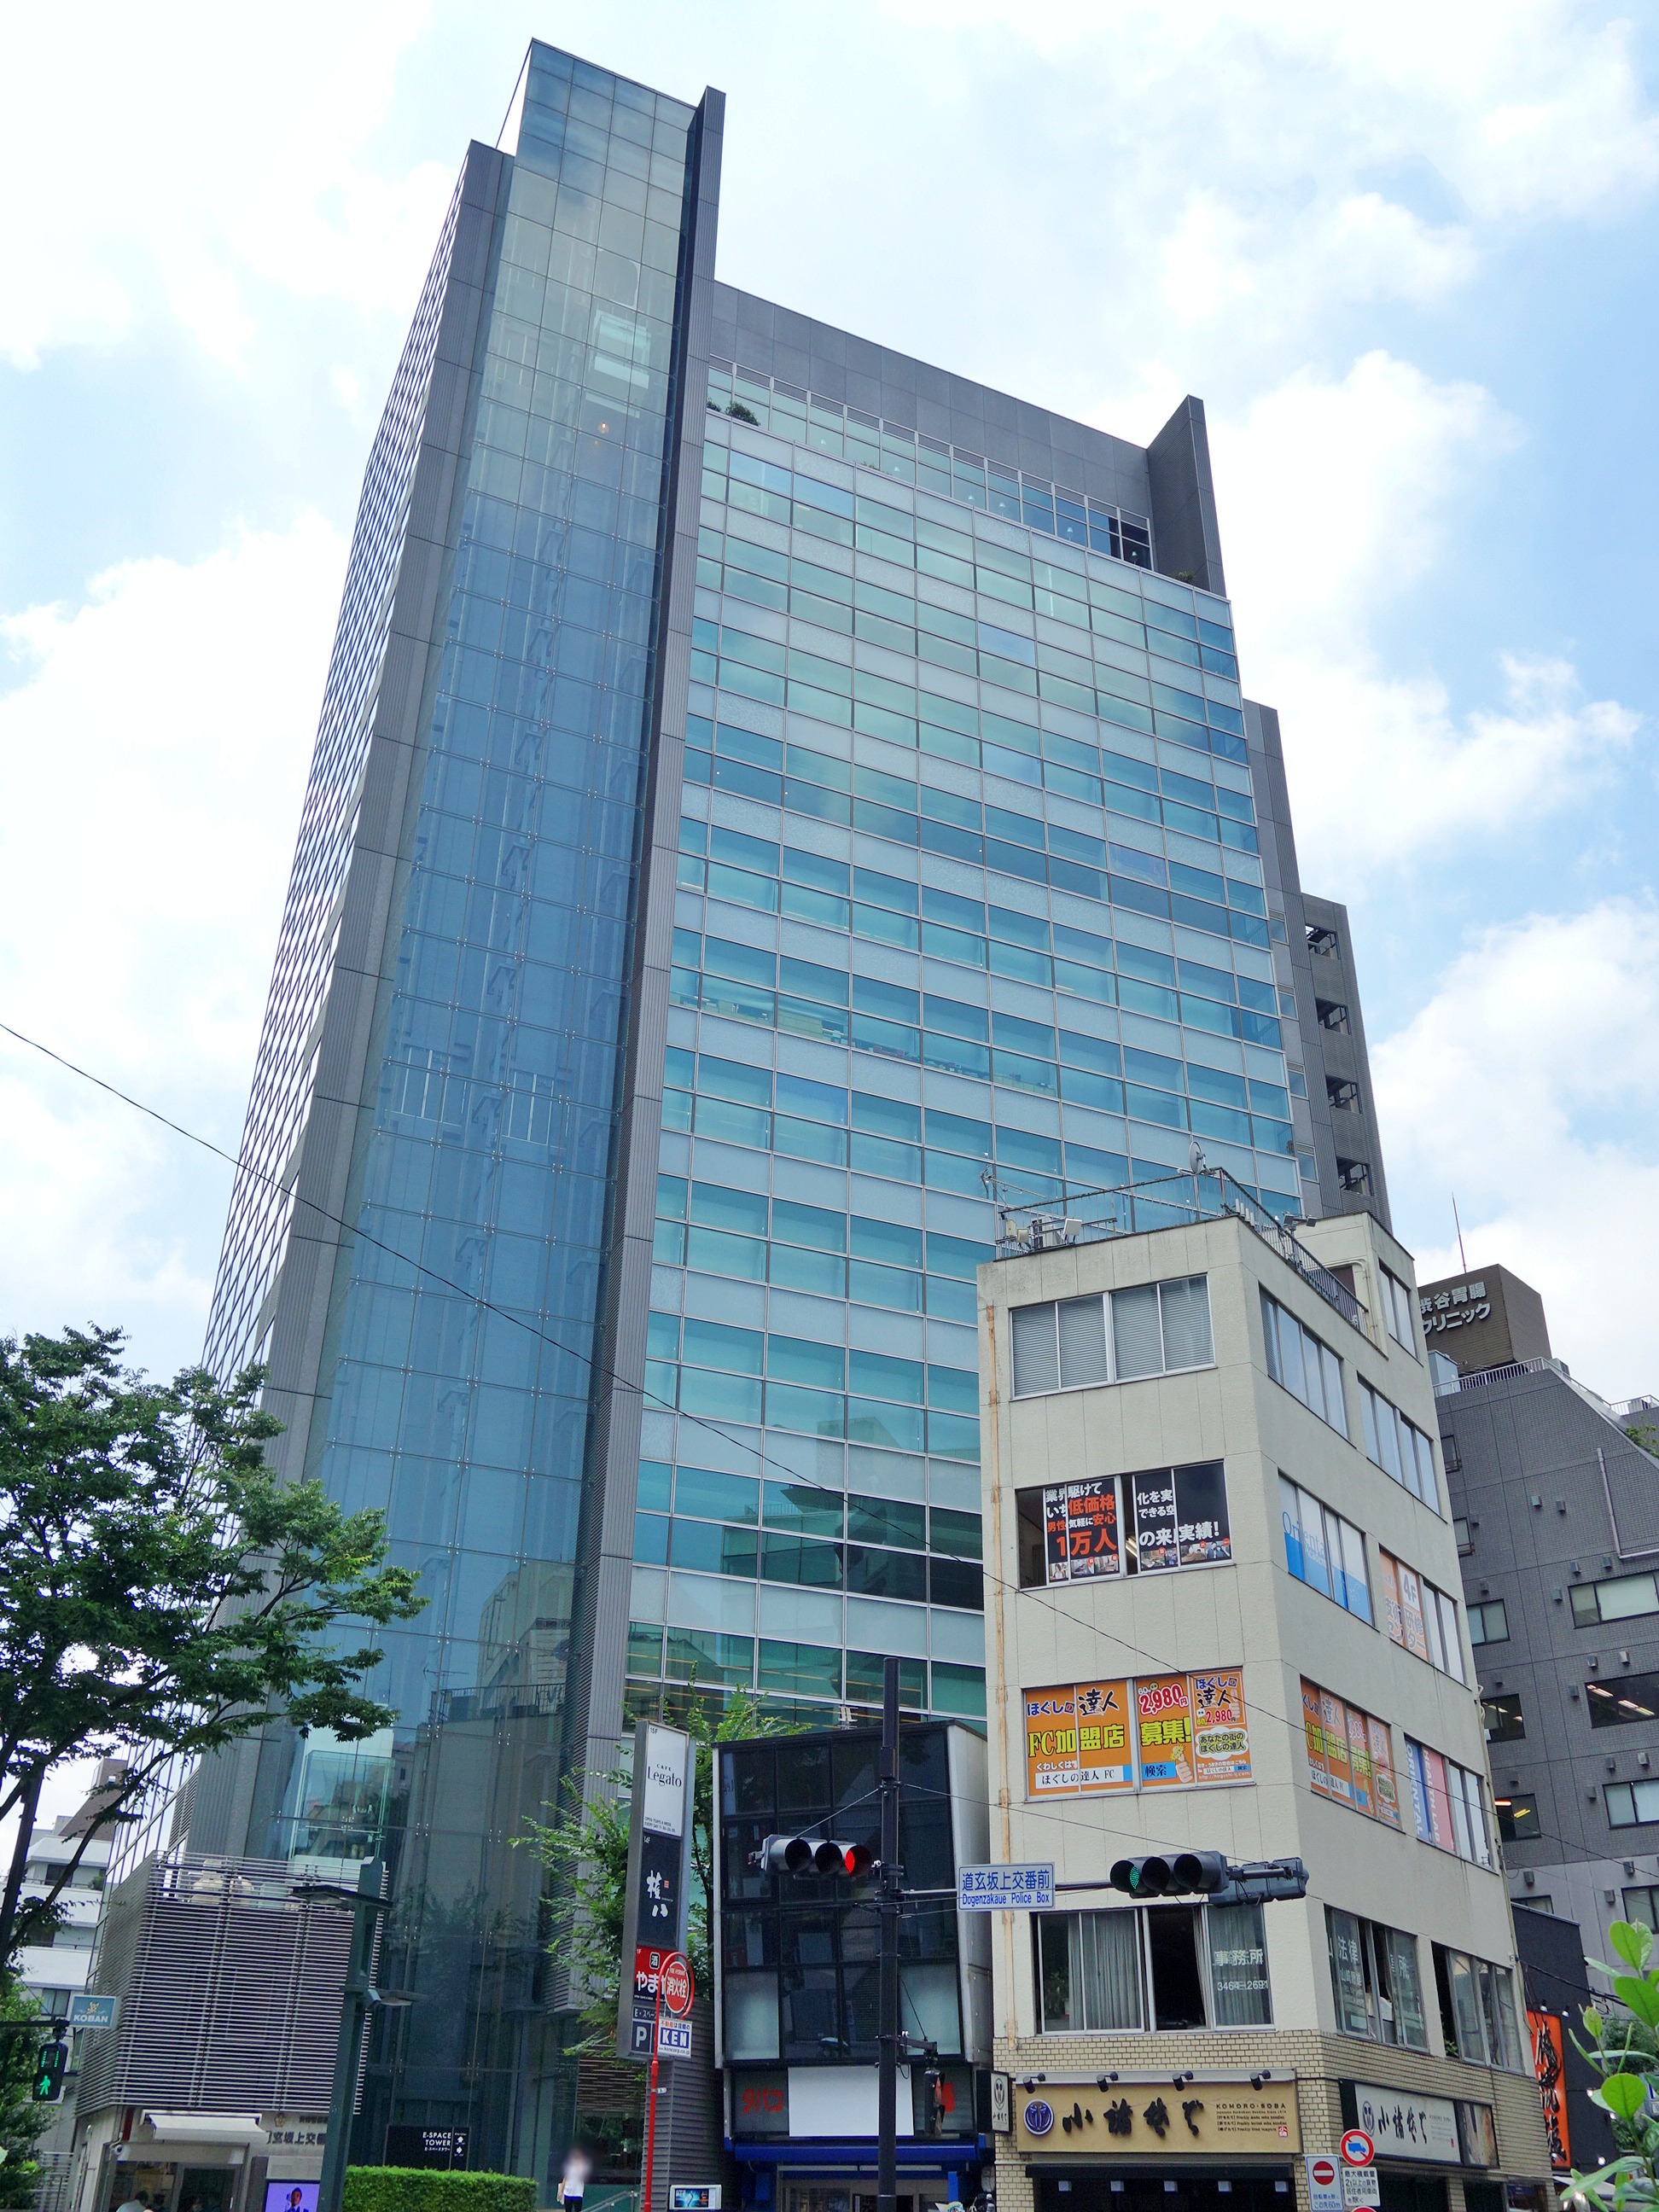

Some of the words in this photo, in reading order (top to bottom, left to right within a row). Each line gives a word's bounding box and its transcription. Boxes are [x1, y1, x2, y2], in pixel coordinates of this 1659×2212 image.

[1028, 1724, 1125, 1757] FC加盟店
[648, 1766, 682, 1788] Legato
[1144, 1764, 1167, 1778] 検索
[962, 1869, 1050, 1891] 道玄坂上交番前
[962, 1893, 1006, 1906] Dogenzakaue
[1011, 1892, 1031, 1904] Police
[1036, 1891, 1050, 1903] Box
[667, 1976, 687, 1999] 消火栓
[73, 2014, 108, 2023] KOBAN
[636, 2026, 647, 2048] P
[662, 2029, 687, 2046] KEN
[742, 2088, 783, 2114] タバコ
